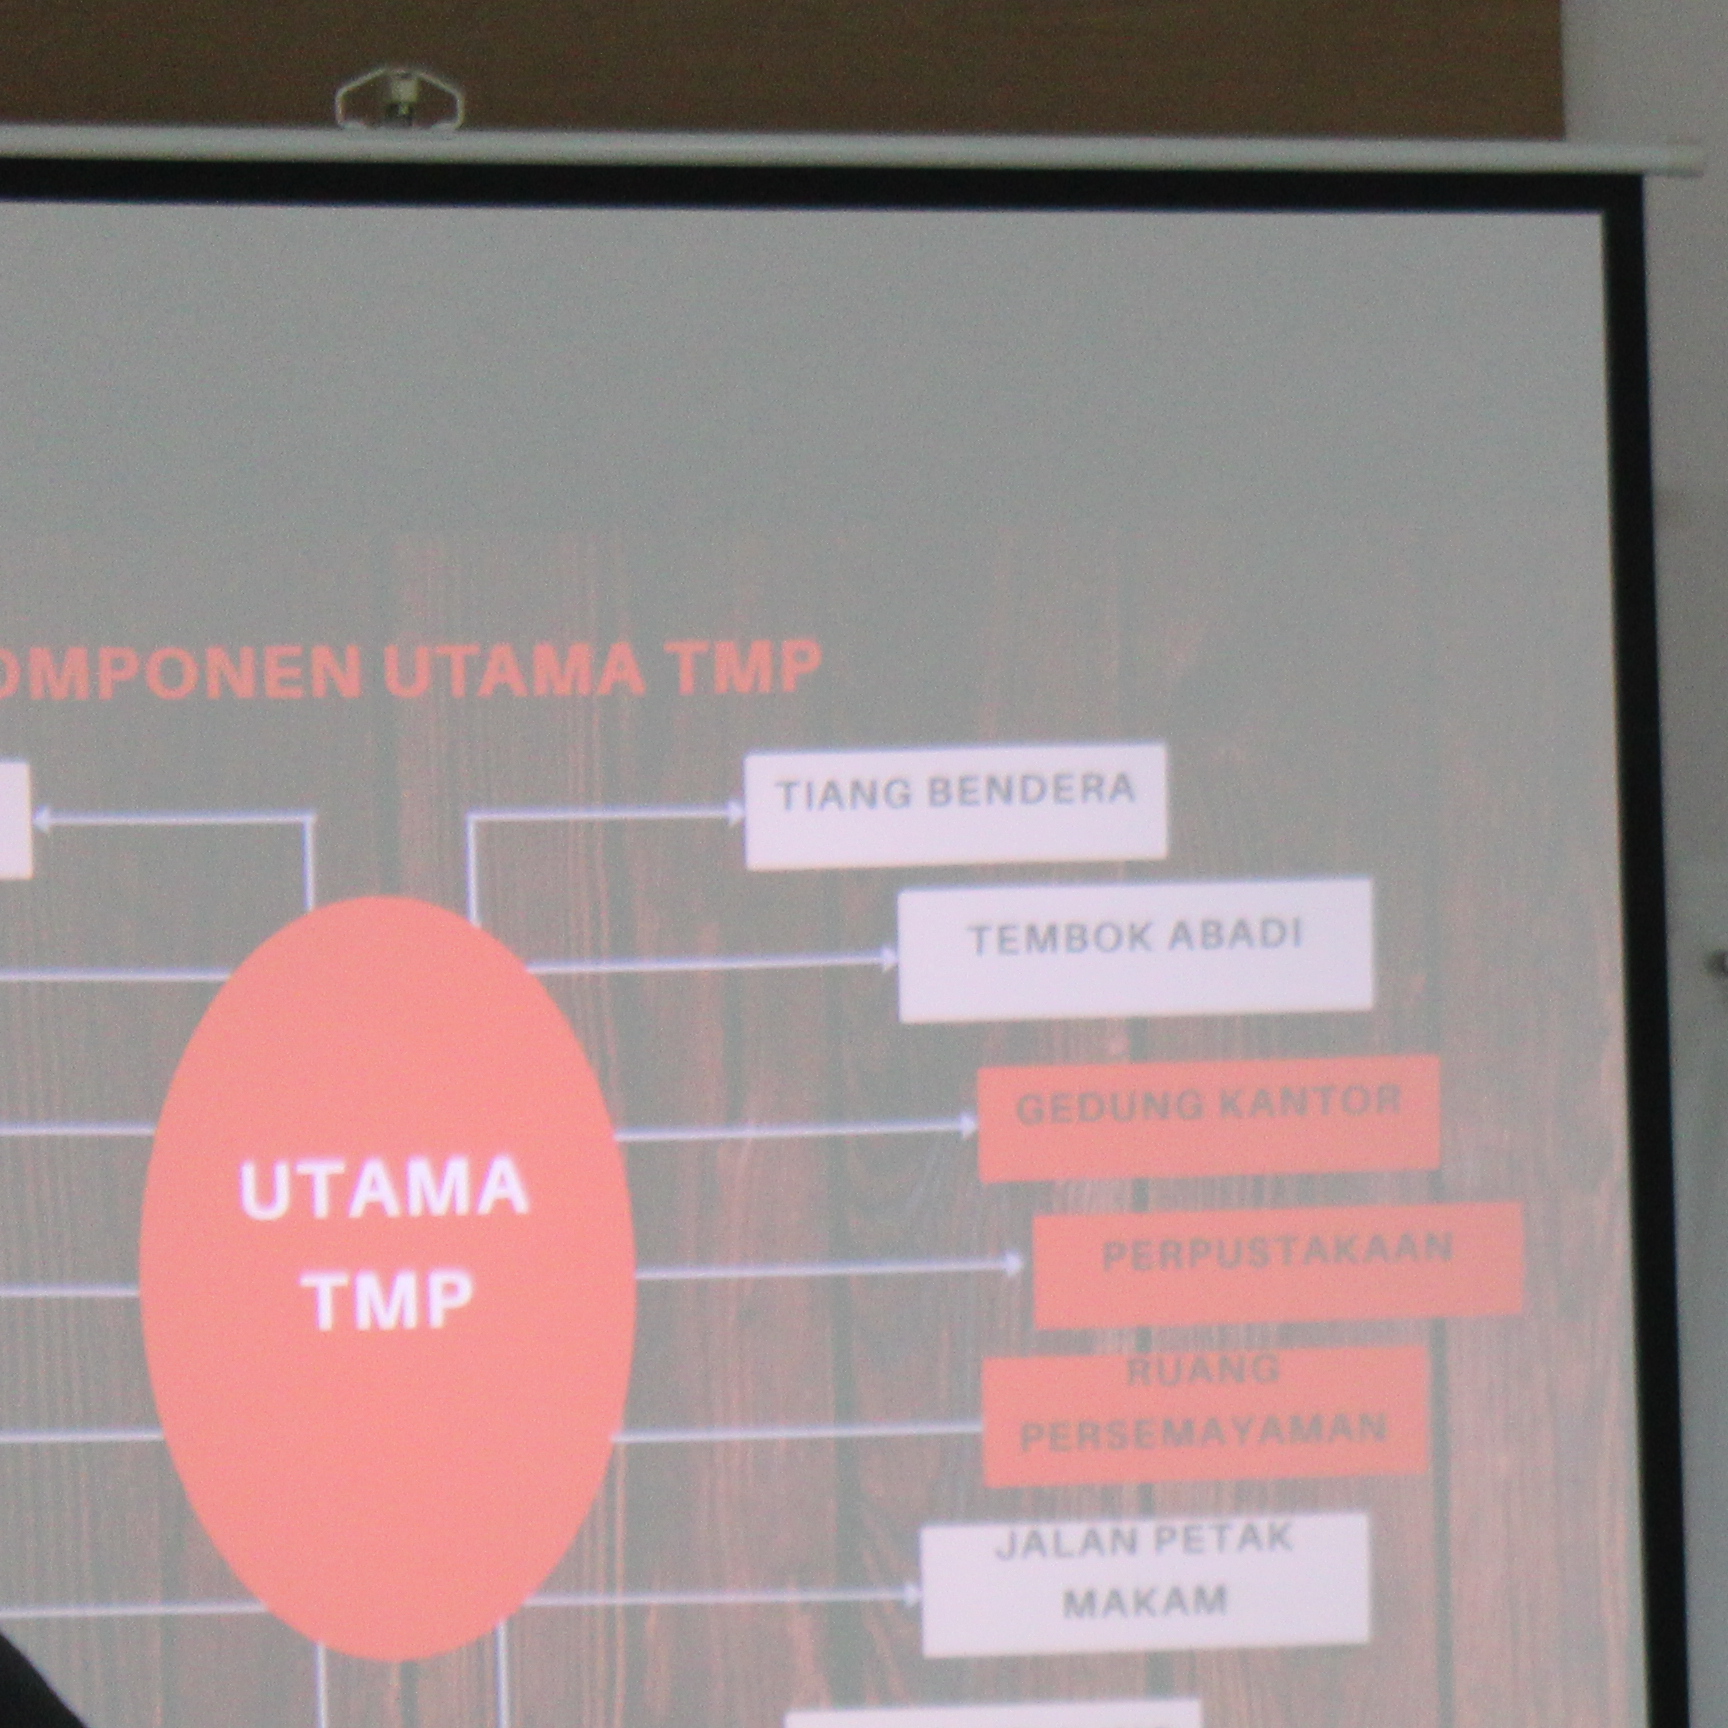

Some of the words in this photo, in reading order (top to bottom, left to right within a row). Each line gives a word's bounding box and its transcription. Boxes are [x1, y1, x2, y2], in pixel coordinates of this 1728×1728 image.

[384, 640, 647, 698] UTAMA
[664, 638, 823, 695] TMP
[776, 775, 912, 812] TIANG
[928, 771, 1136, 808] BENDERA
[966, 920, 1154, 956] TEMBOK
[1167, 916, 1303, 951] ABADI
[1015, 1088, 1206, 1126] GEDUNG
[1218, 1083, 1400, 1120] KANTOR
[239, 1153, 531, 1222] UTAMA
[1103, 1231, 1454, 1273] PERPUSTAKAAN
[298, 1266, 475, 1333] TMP
[1125, 1353, 1281, 1388] RUANG
[1019, 1411, 1389, 1454] PERSEMAYAMAN
[994, 1526, 1138, 1562] JALAN
[1153, 1521, 1294, 1556] PETAK
[1062, 1583, 1228, 1619] MAKAM
